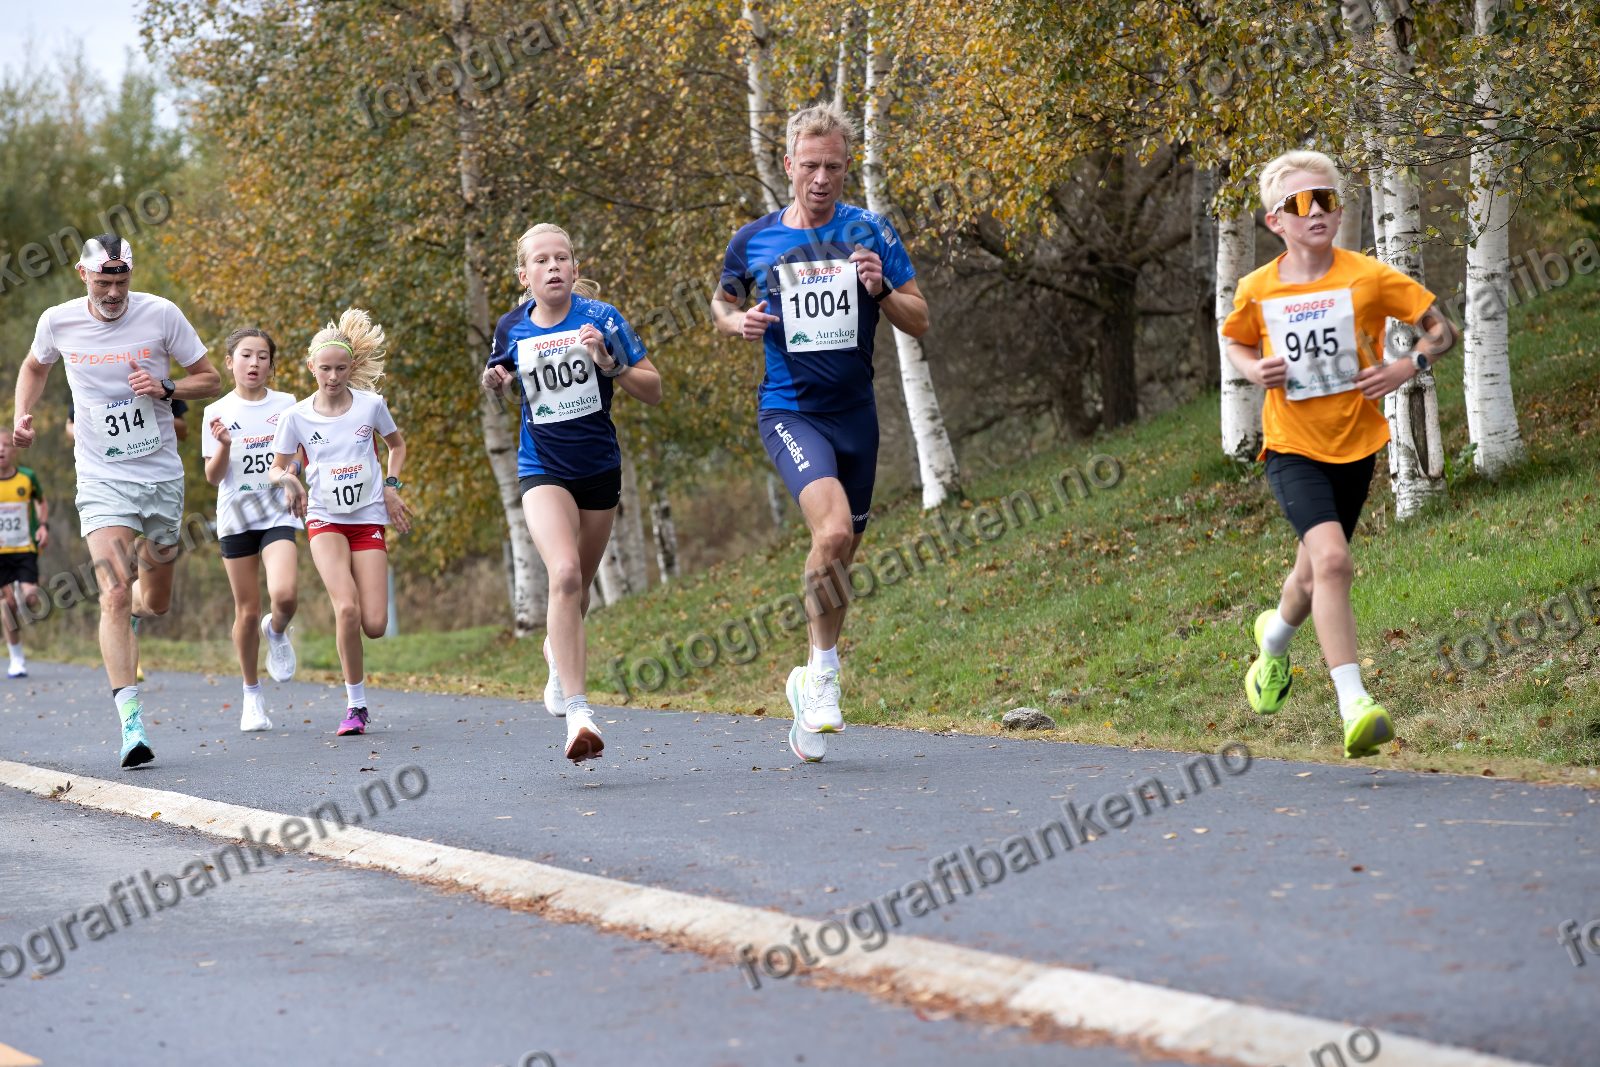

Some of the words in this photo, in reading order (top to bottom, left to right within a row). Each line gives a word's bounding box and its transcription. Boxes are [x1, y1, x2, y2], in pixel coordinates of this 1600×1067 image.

[798, 266, 842, 277] NORGES
[802, 275, 835, 285] LØPET
[789, 290, 851, 319] 1004
[1284, 299, 1335, 313] NORGES
[1289, 310, 1328, 323] LØPET
[815, 328, 856, 341] Aurskog
[533, 337, 577, 351] NORGES
[1285, 327, 1339, 362] 945
[538, 346, 571, 358] LØPET
[528, 359, 589, 392] 1003
[557, 395, 598, 411] Aurskog
[105, 408, 145, 437] 314
[126, 436, 161, 451] Aurskog
[246, 442, 270, 450] LØPET
[243, 452, 275, 475] 259
[330, 464, 363, 476] NORGES
[334, 472, 359, 481] LØPET
[332, 483, 364, 506] 107
